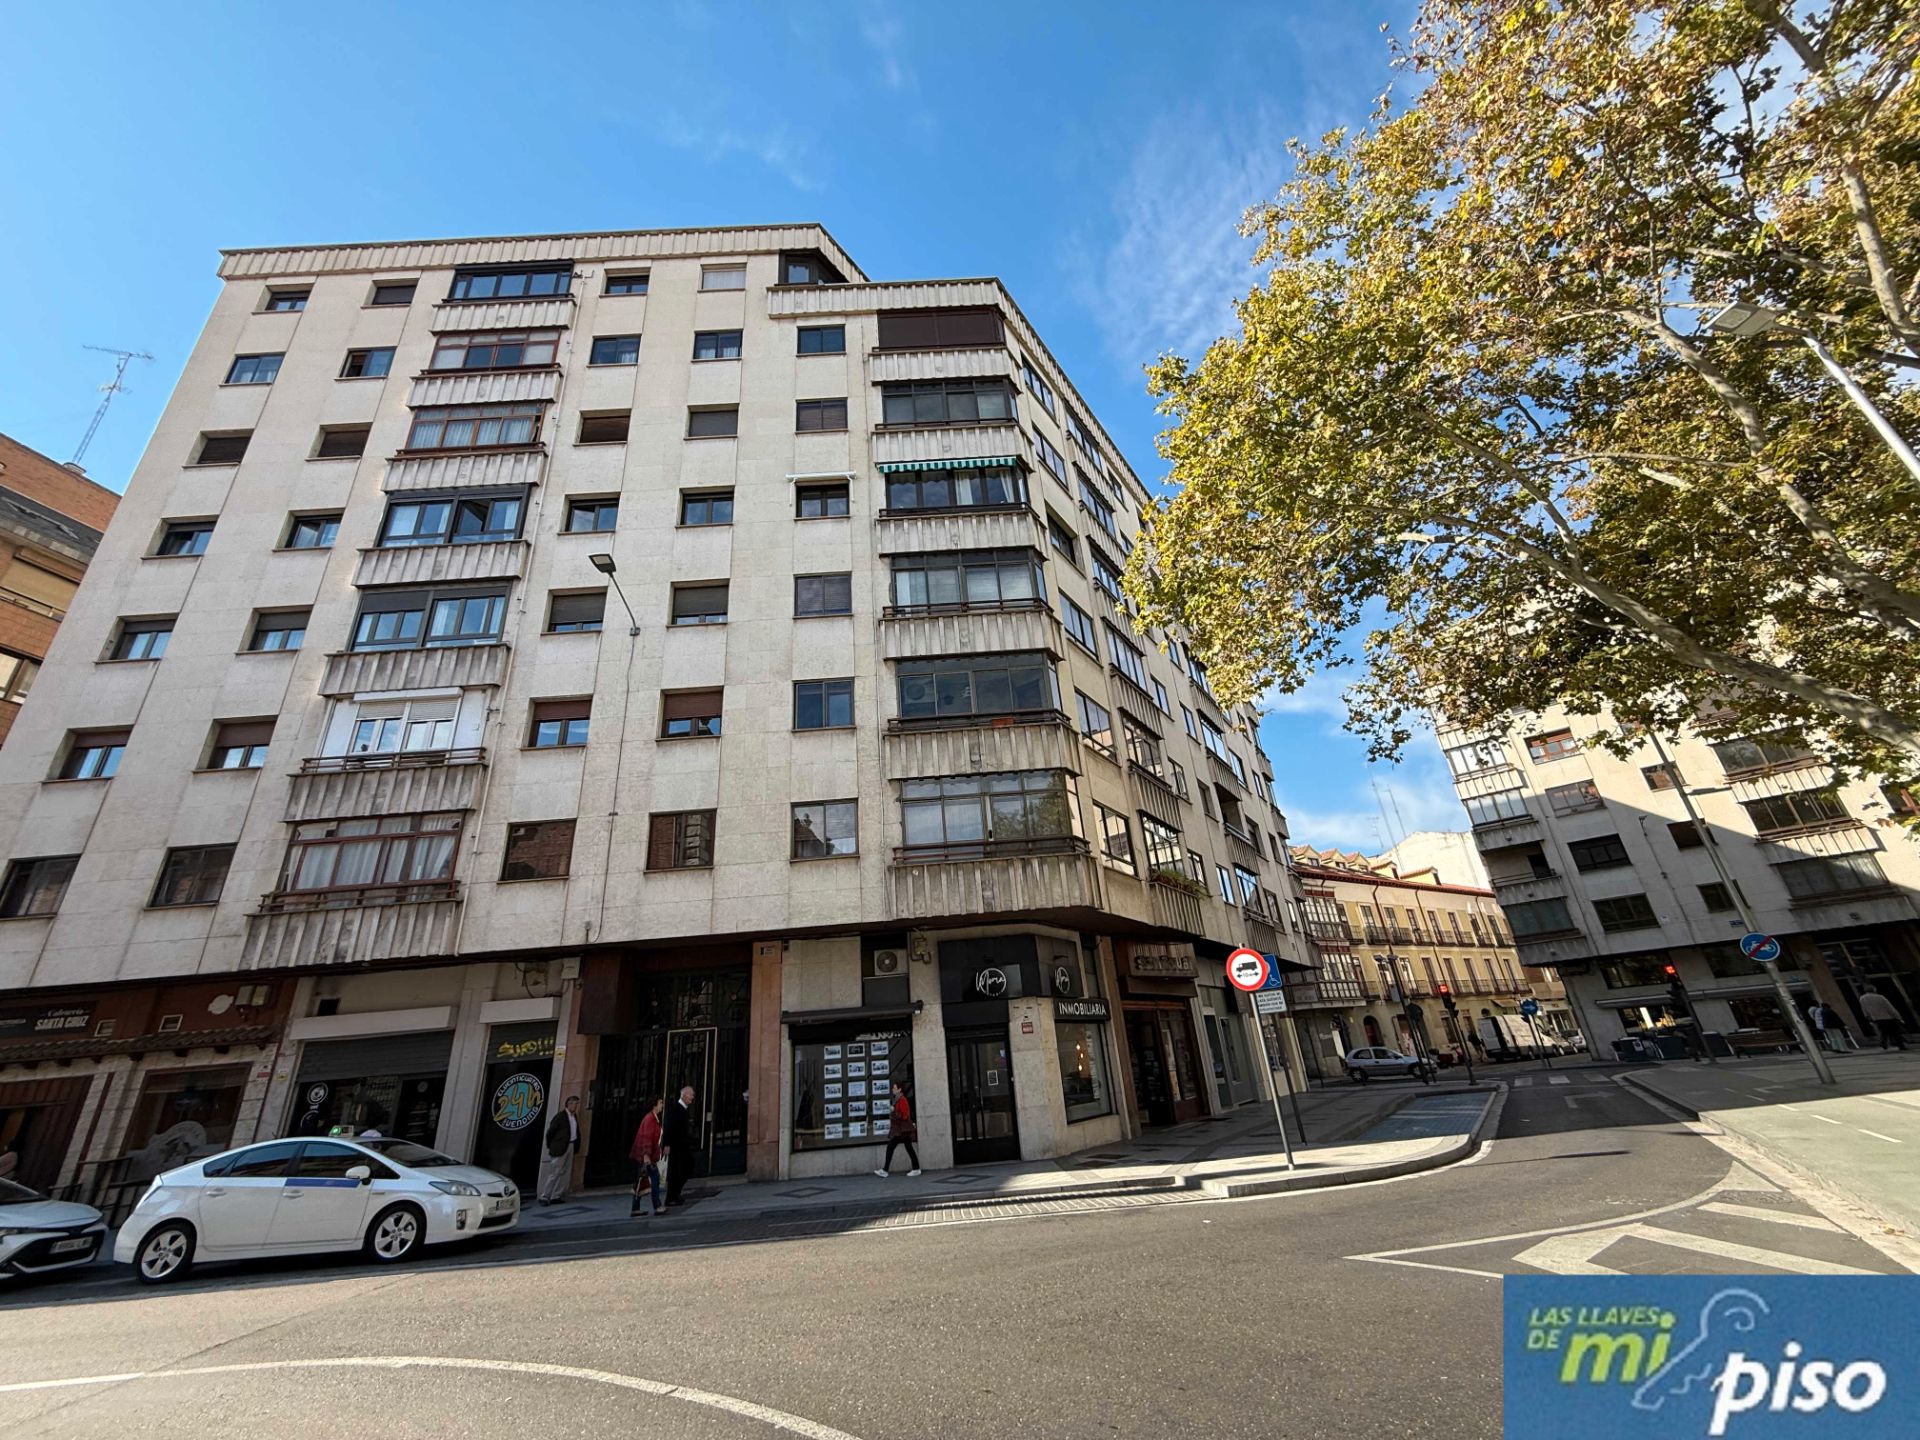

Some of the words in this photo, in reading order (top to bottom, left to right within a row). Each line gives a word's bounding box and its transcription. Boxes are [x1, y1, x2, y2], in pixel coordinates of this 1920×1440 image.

[1058, 1002, 1107, 1015] INMOBILIARIA
[34, 1017, 65, 1031] SANTA
[64, 1015, 90, 1028] CRUZ
[493, 1084, 544, 1122] 24h
